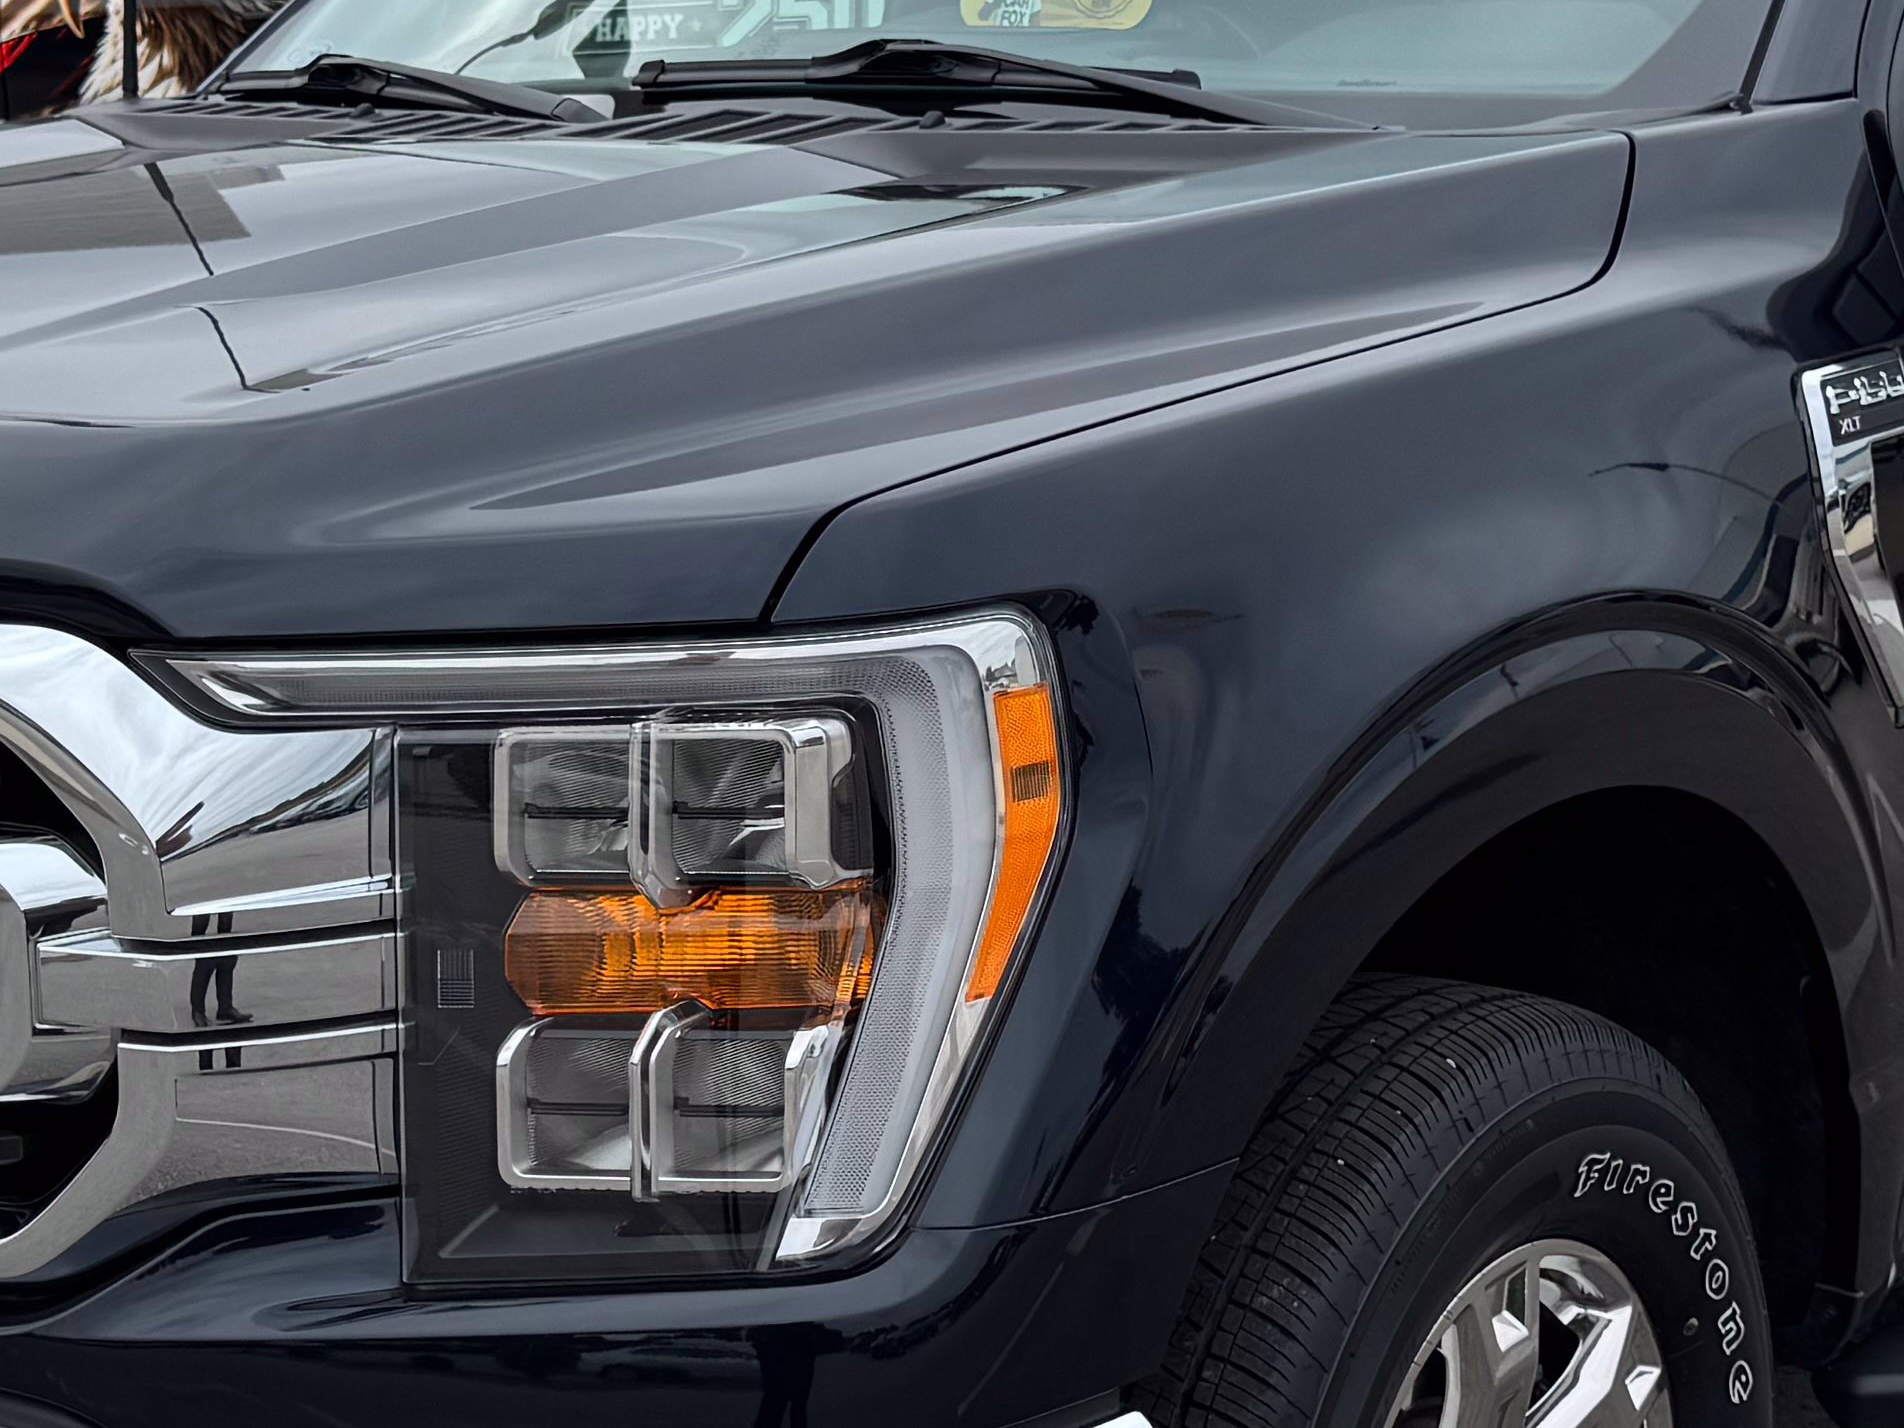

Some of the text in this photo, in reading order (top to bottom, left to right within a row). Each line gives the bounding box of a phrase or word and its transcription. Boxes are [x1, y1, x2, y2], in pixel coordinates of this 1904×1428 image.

[596, 14, 684, 43] HAPPY
[1001, 9, 1027, 27] FOX
[1839, 415, 1861, 435] XLT
[1574, 1151, 1754, 1405] Firestone
